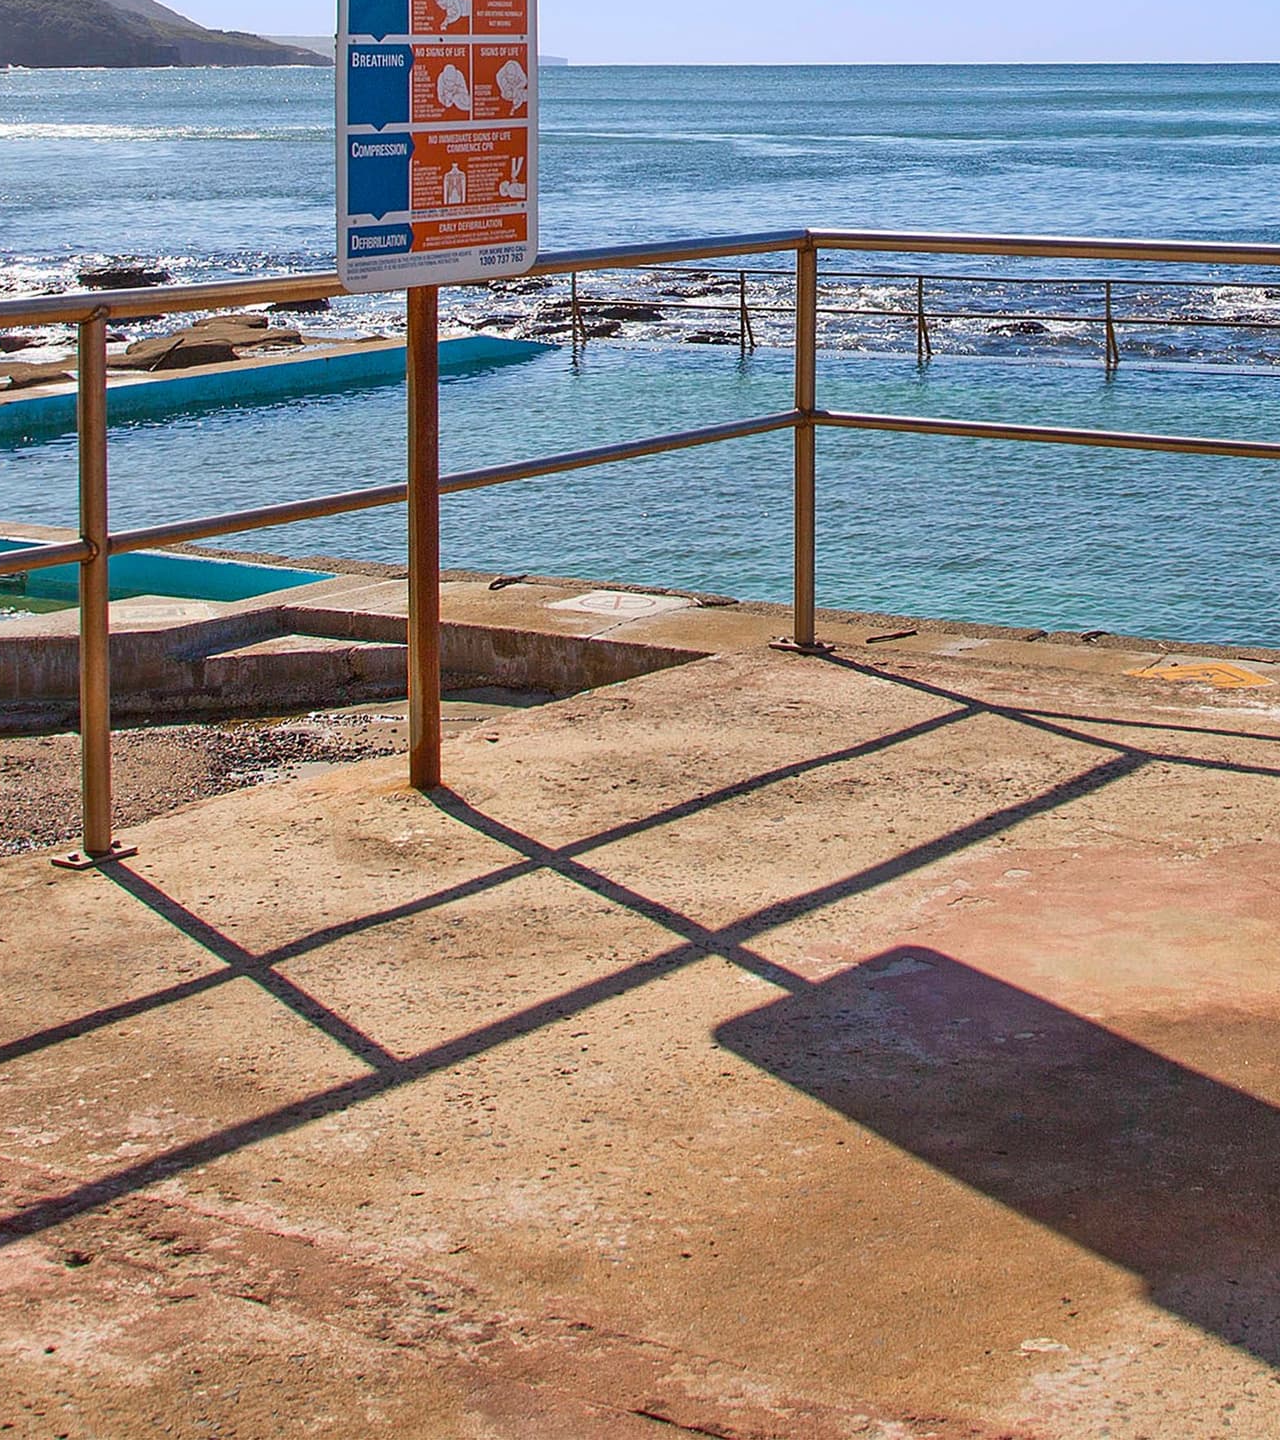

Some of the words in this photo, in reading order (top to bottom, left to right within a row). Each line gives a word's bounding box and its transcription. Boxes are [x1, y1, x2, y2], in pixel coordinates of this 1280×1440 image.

[415, 48, 425, 57] NO
[426, 47, 445, 57] SIGNS
[445, 47, 453, 57] OF
[454, 47, 465, 56] LIFE
[480, 47, 499, 57] SIGNS
[499, 47, 507, 57] OF
[508, 47, 519, 56] LIFE
[352, 52, 404, 68] BREATHING
[428, 135, 438, 144] NO
[438, 133, 472, 144] IMMEDIATE
[473, 132, 491, 142] SIGNS
[492, 132, 499, 141] OF
[500, 131, 511, 141] LIFE
[352, 142, 407, 158] COMPRESSION
[447, 143, 481, 153] COMMENCE
[482, 142, 493, 151] CPR
[439, 222, 457, 233] EARLY
[458, 219, 503, 231] DEFIBRILLATION
[352, 234, 407, 251] DEFIBRILLATION
[480, 256, 496, 266] 1300
[497, 254, 509, 264] 737
[511, 253, 523, 263] 763
